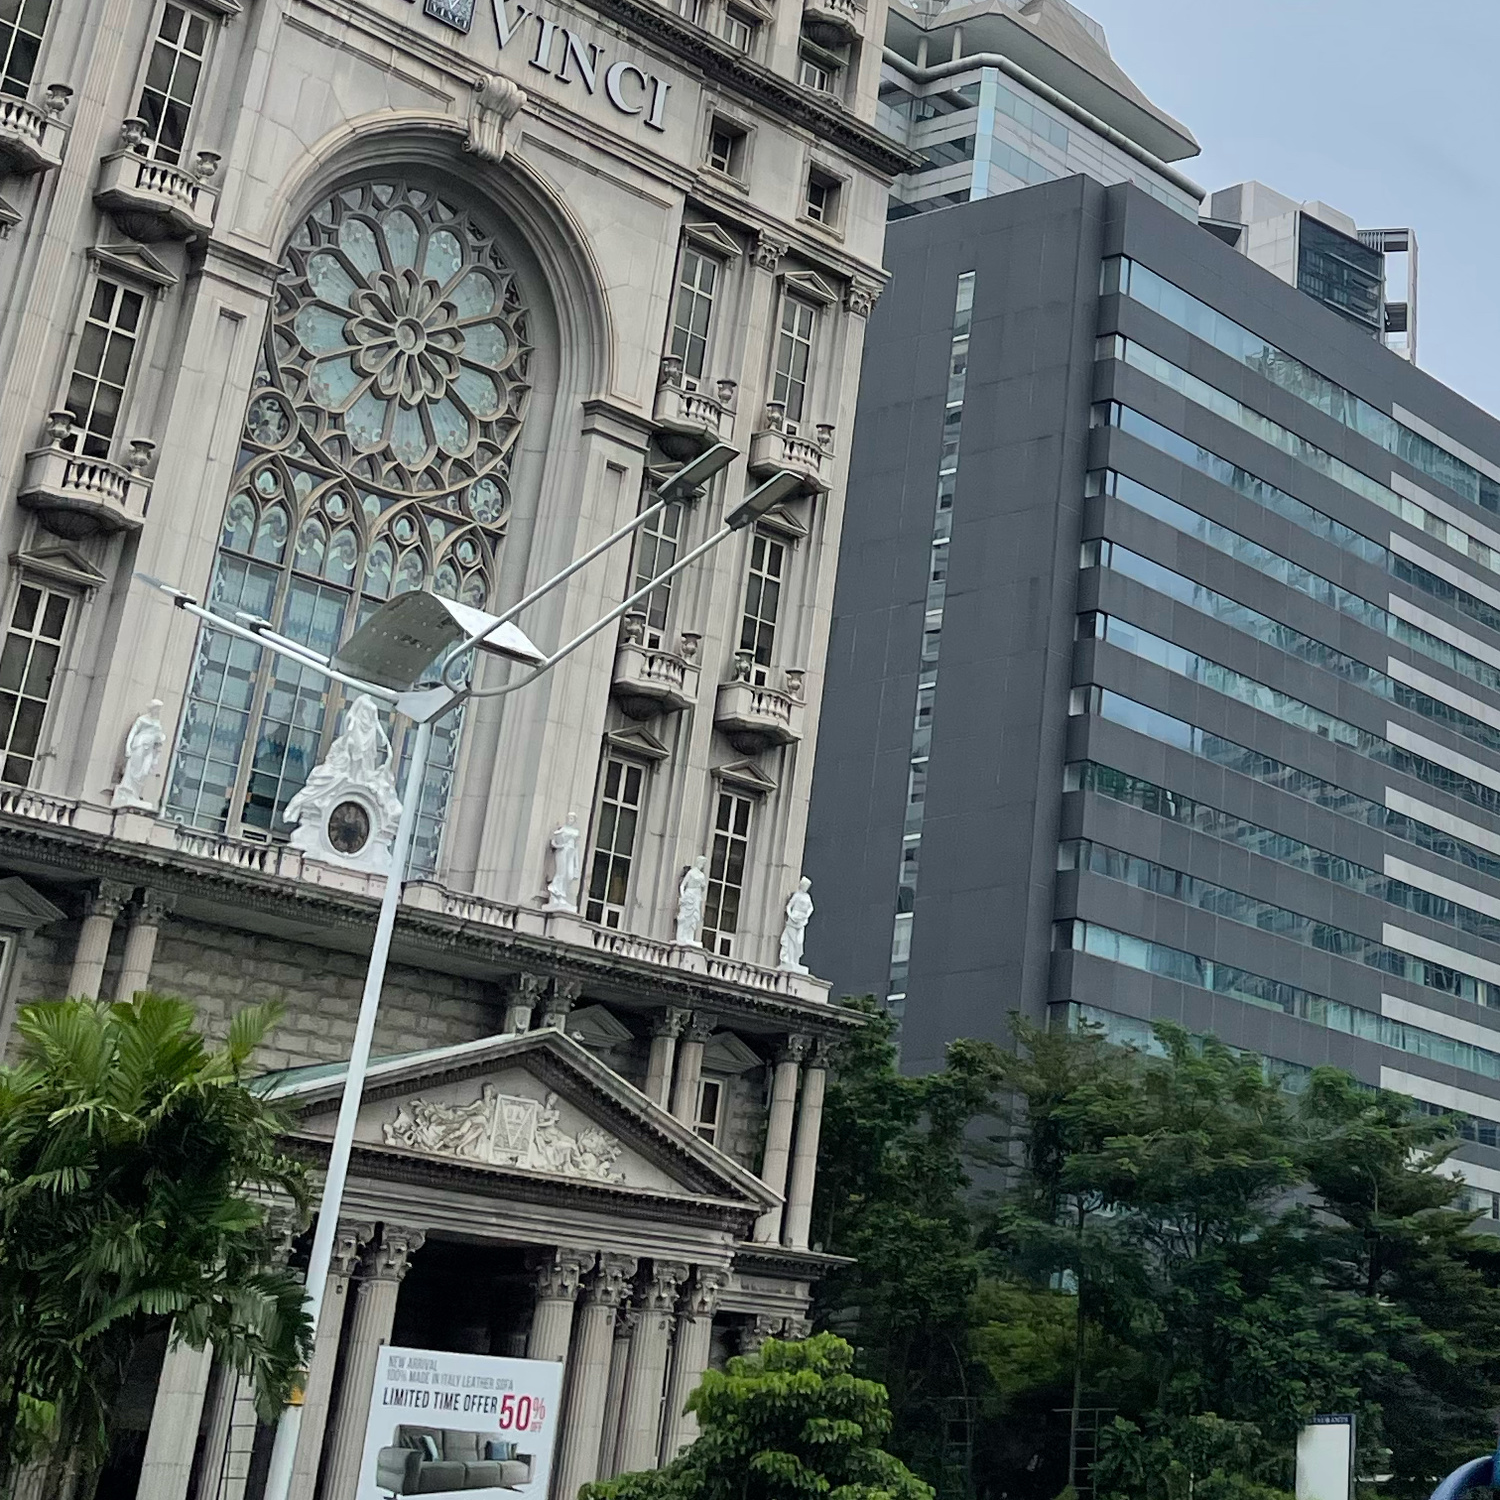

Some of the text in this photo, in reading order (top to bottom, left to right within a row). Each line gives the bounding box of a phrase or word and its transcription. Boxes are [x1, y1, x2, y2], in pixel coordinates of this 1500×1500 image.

[388, 1355, 438, 1372] NEW ARRIVAL
[386, 1368, 514, 1391] 100% MADE IN ITALY LEATHER SOFA
[383, 1387, 498, 1414] LIMITED TIME OFFER
